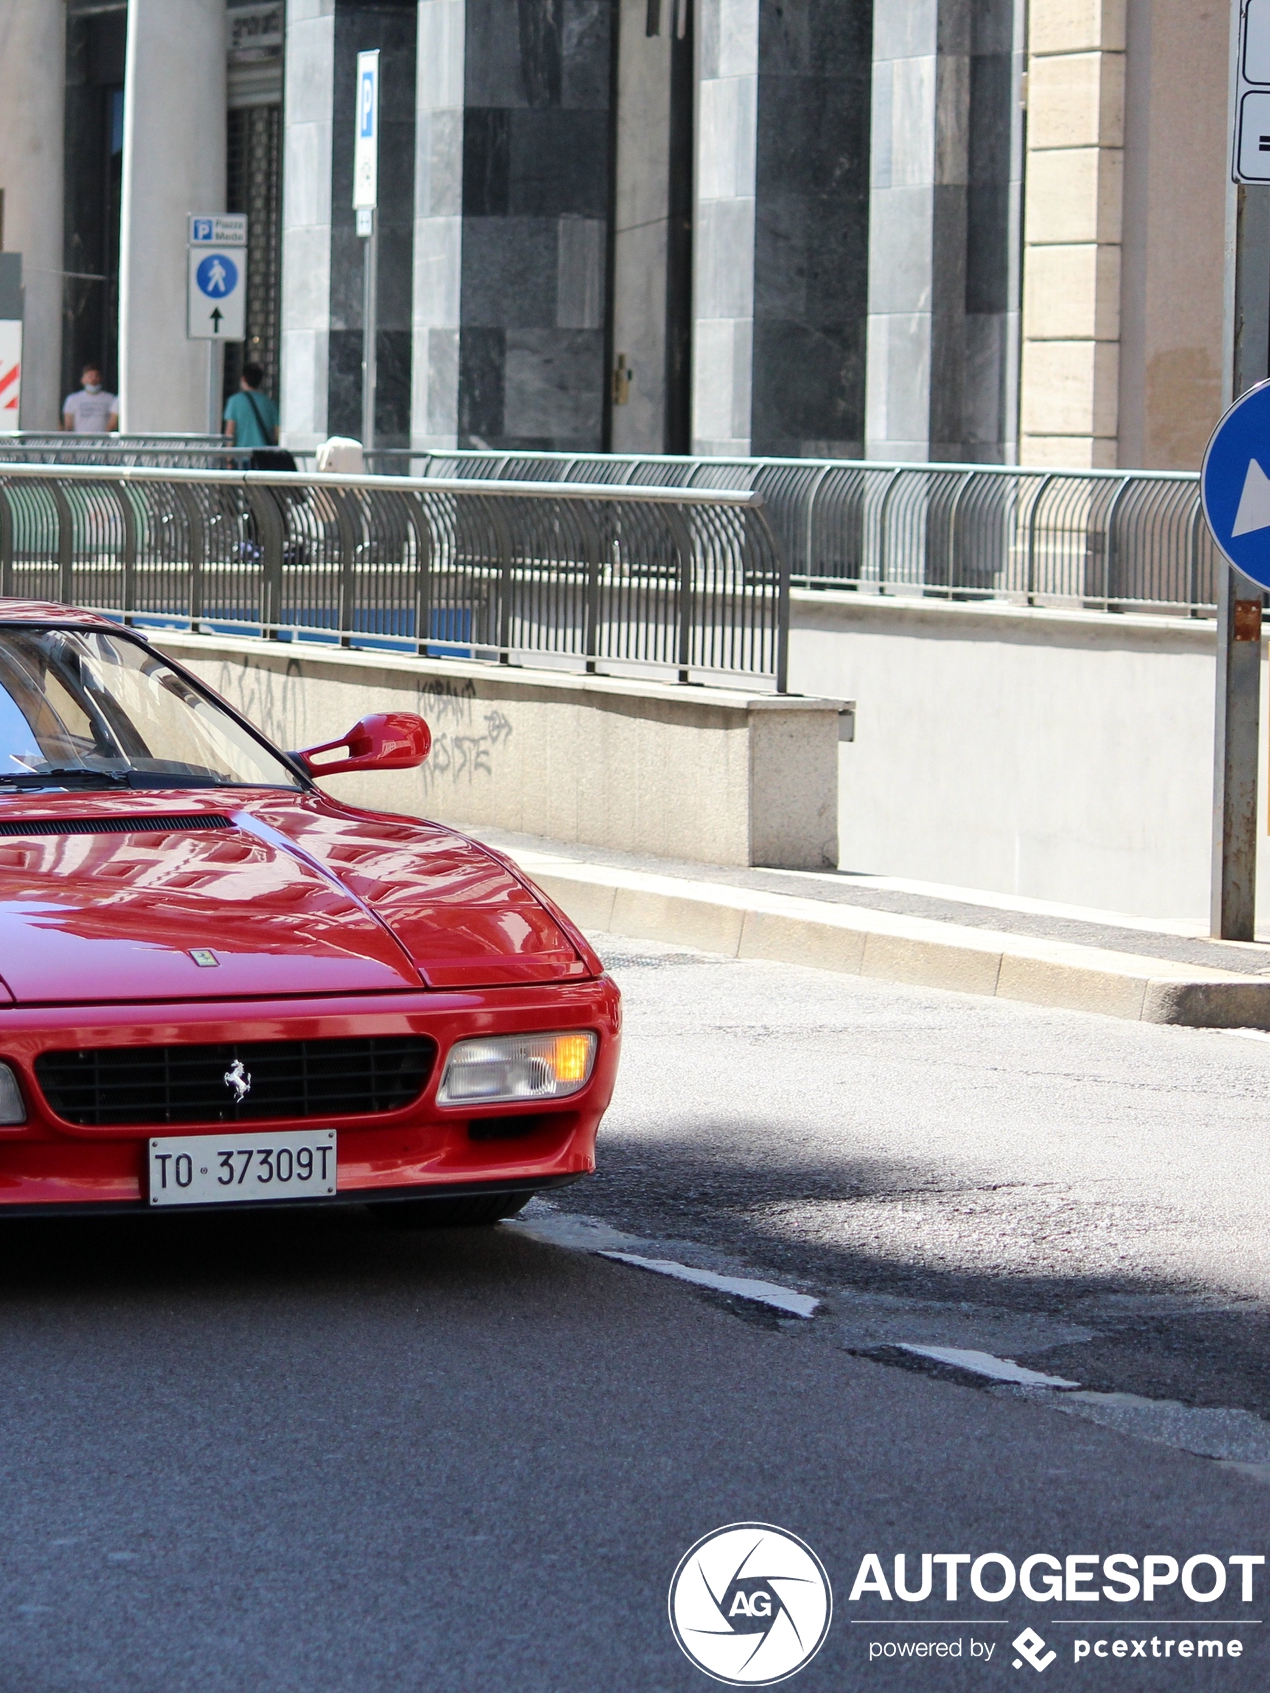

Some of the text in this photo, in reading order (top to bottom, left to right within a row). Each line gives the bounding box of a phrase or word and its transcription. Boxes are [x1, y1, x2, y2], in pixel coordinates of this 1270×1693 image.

[216, 219, 243, 229] Piazza
[199, 223, 210, 239] P
[215, 232, 243, 240] Meda
[155, 1145, 333, 1189] TO 37309T
